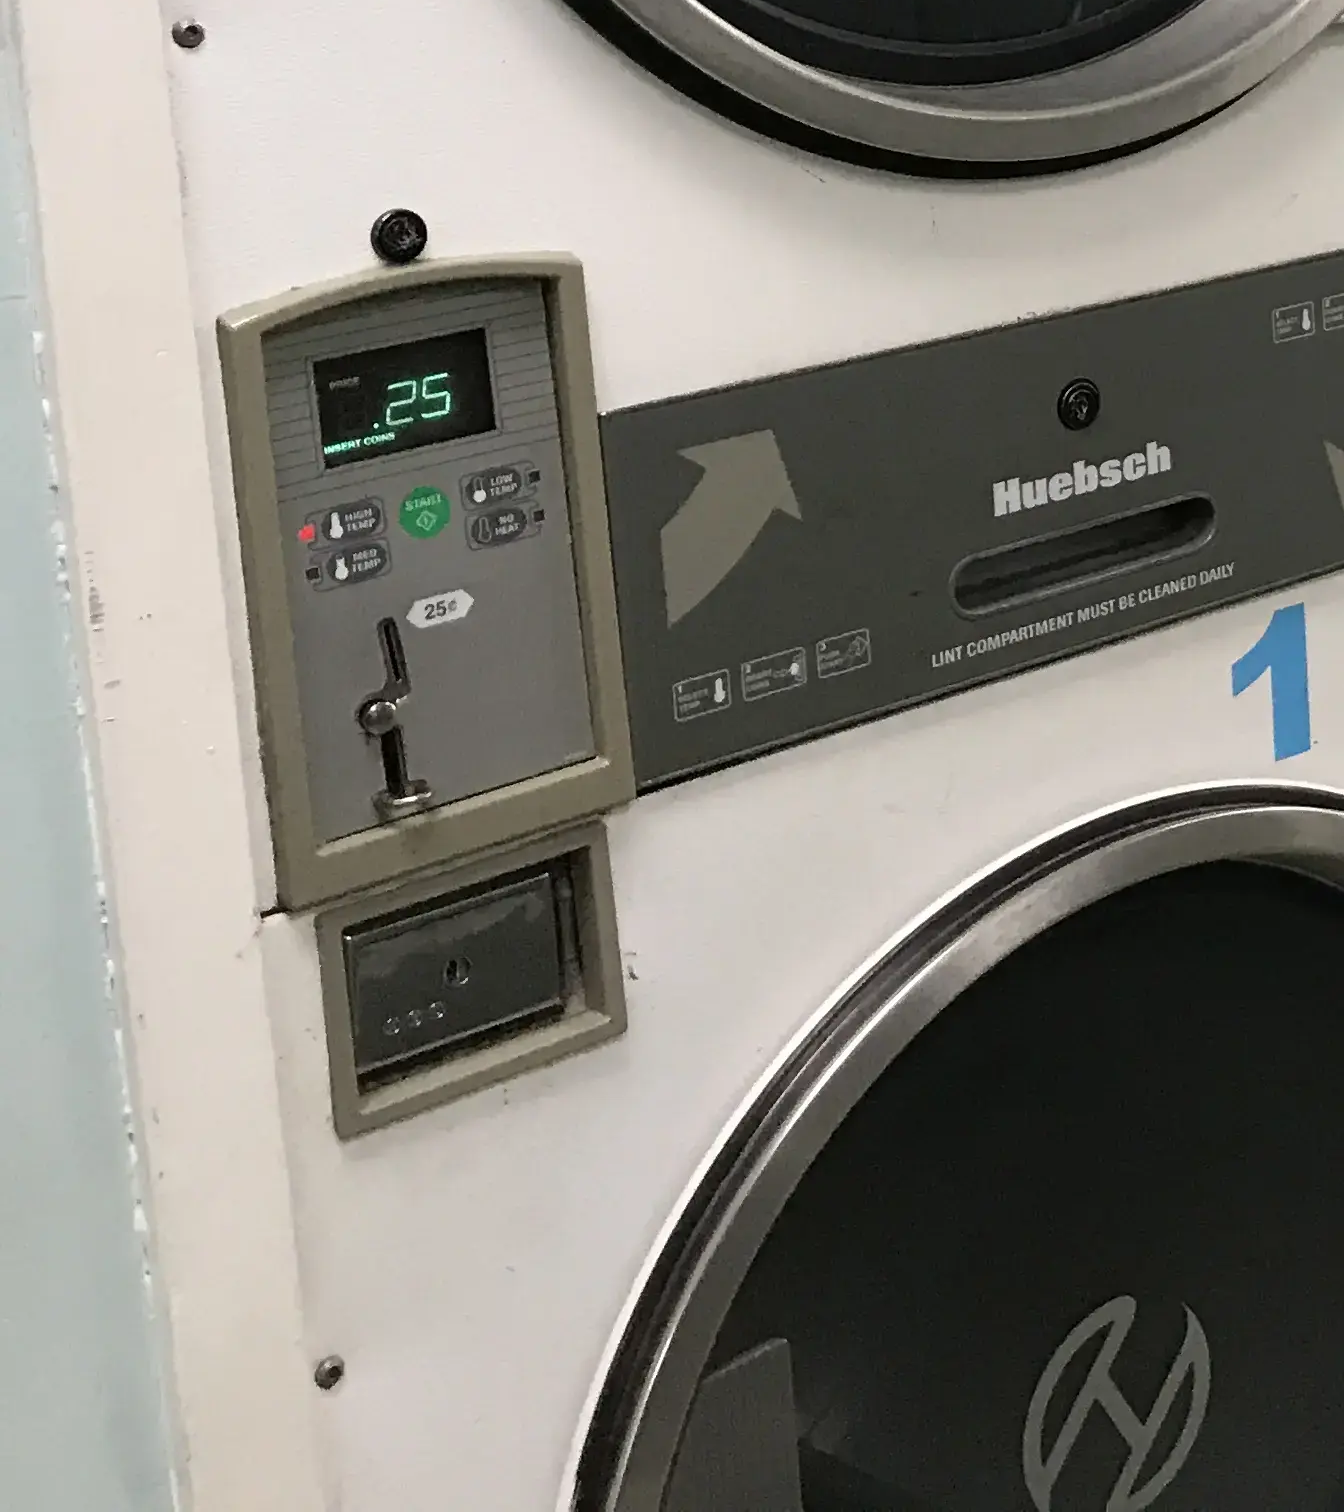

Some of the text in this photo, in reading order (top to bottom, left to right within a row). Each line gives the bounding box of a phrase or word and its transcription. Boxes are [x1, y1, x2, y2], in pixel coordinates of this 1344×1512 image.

[373, 372, 451, 429] .25
[324, 431, 396, 455] INSERT COINS
[490, 473, 514, 487] LOW
[992, 440, 1172, 517] Huebsch
[490, 483, 519, 498] TEMP
[404, 493, 443, 512] START
[344, 508, 373, 522] HIGH
[498, 513, 515, 525] NO
[347, 518, 376, 532] TEMP
[352, 548, 378, 562] MED
[351, 558, 382, 574] TEMP
[424, 597, 457, 620] 25¢
[931, 561, 1236, 668] LINT COMPARTMENT MUST BE CLEANED DAILY
